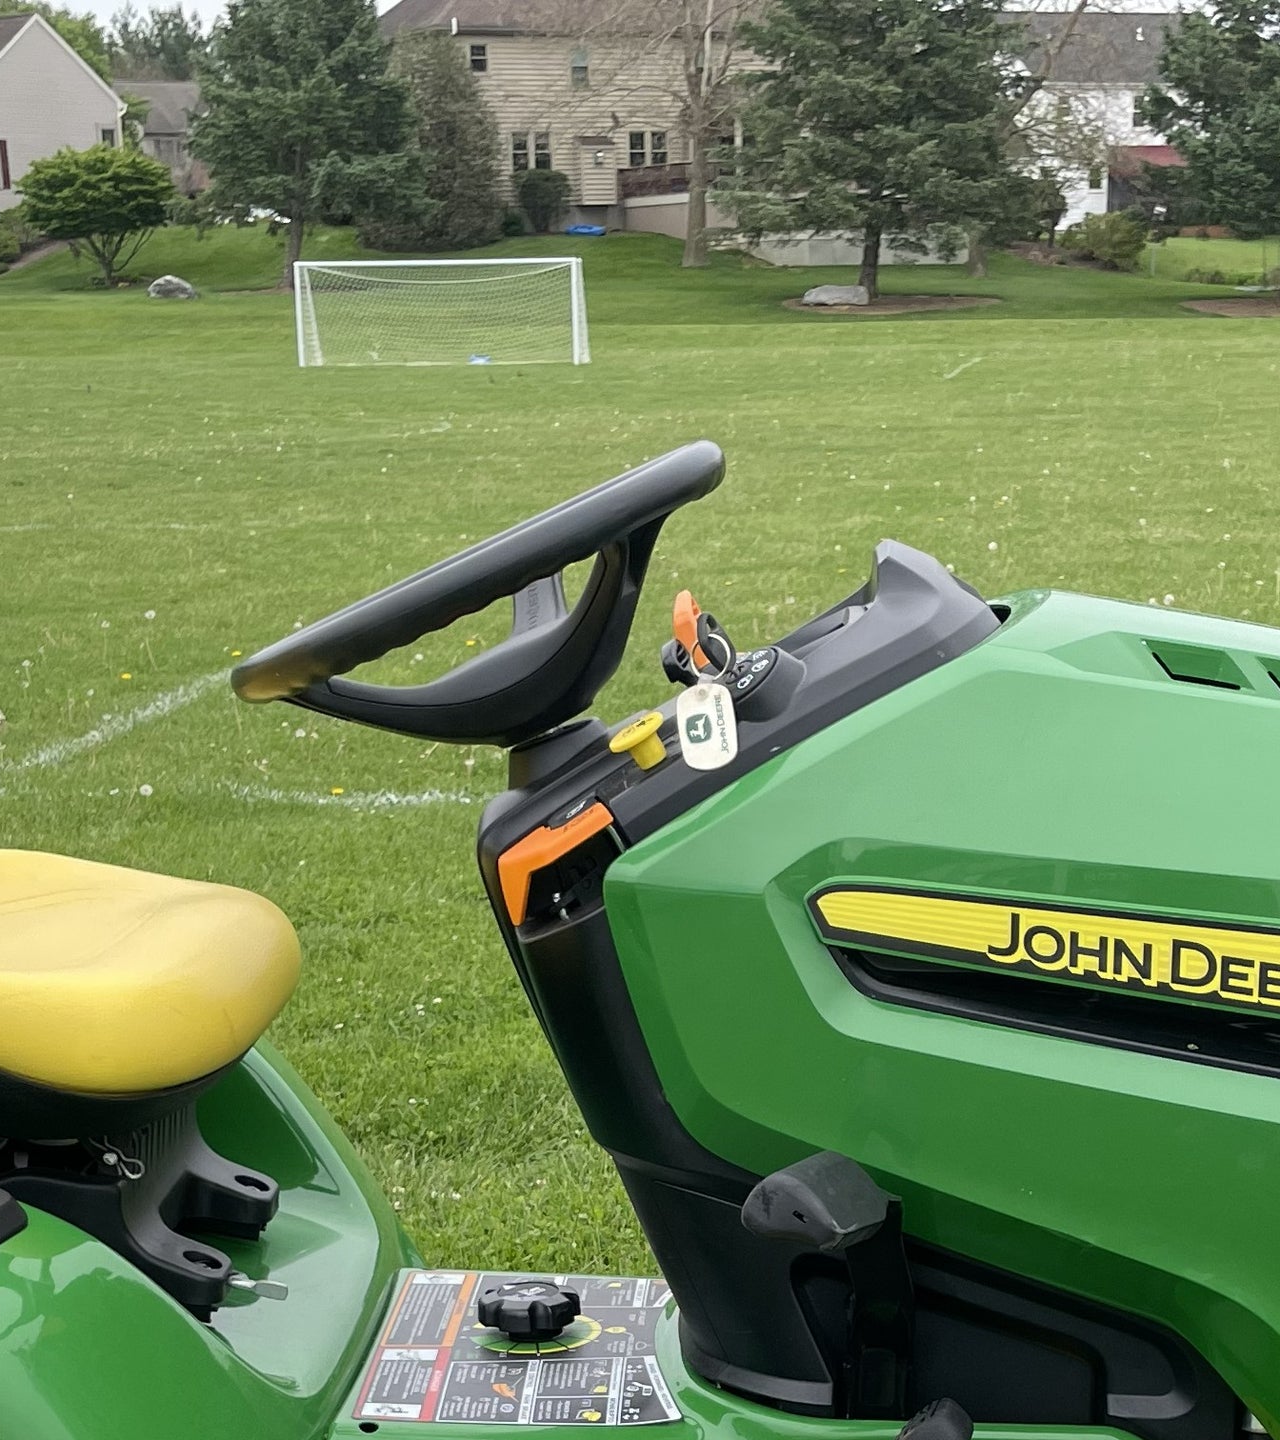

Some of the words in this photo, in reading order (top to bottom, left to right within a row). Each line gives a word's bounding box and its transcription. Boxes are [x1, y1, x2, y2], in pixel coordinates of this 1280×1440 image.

[714, 694, 725, 727] DEERE
[719, 727, 730, 754] JOHN
[987, 912, 1154, 982] JOHN
